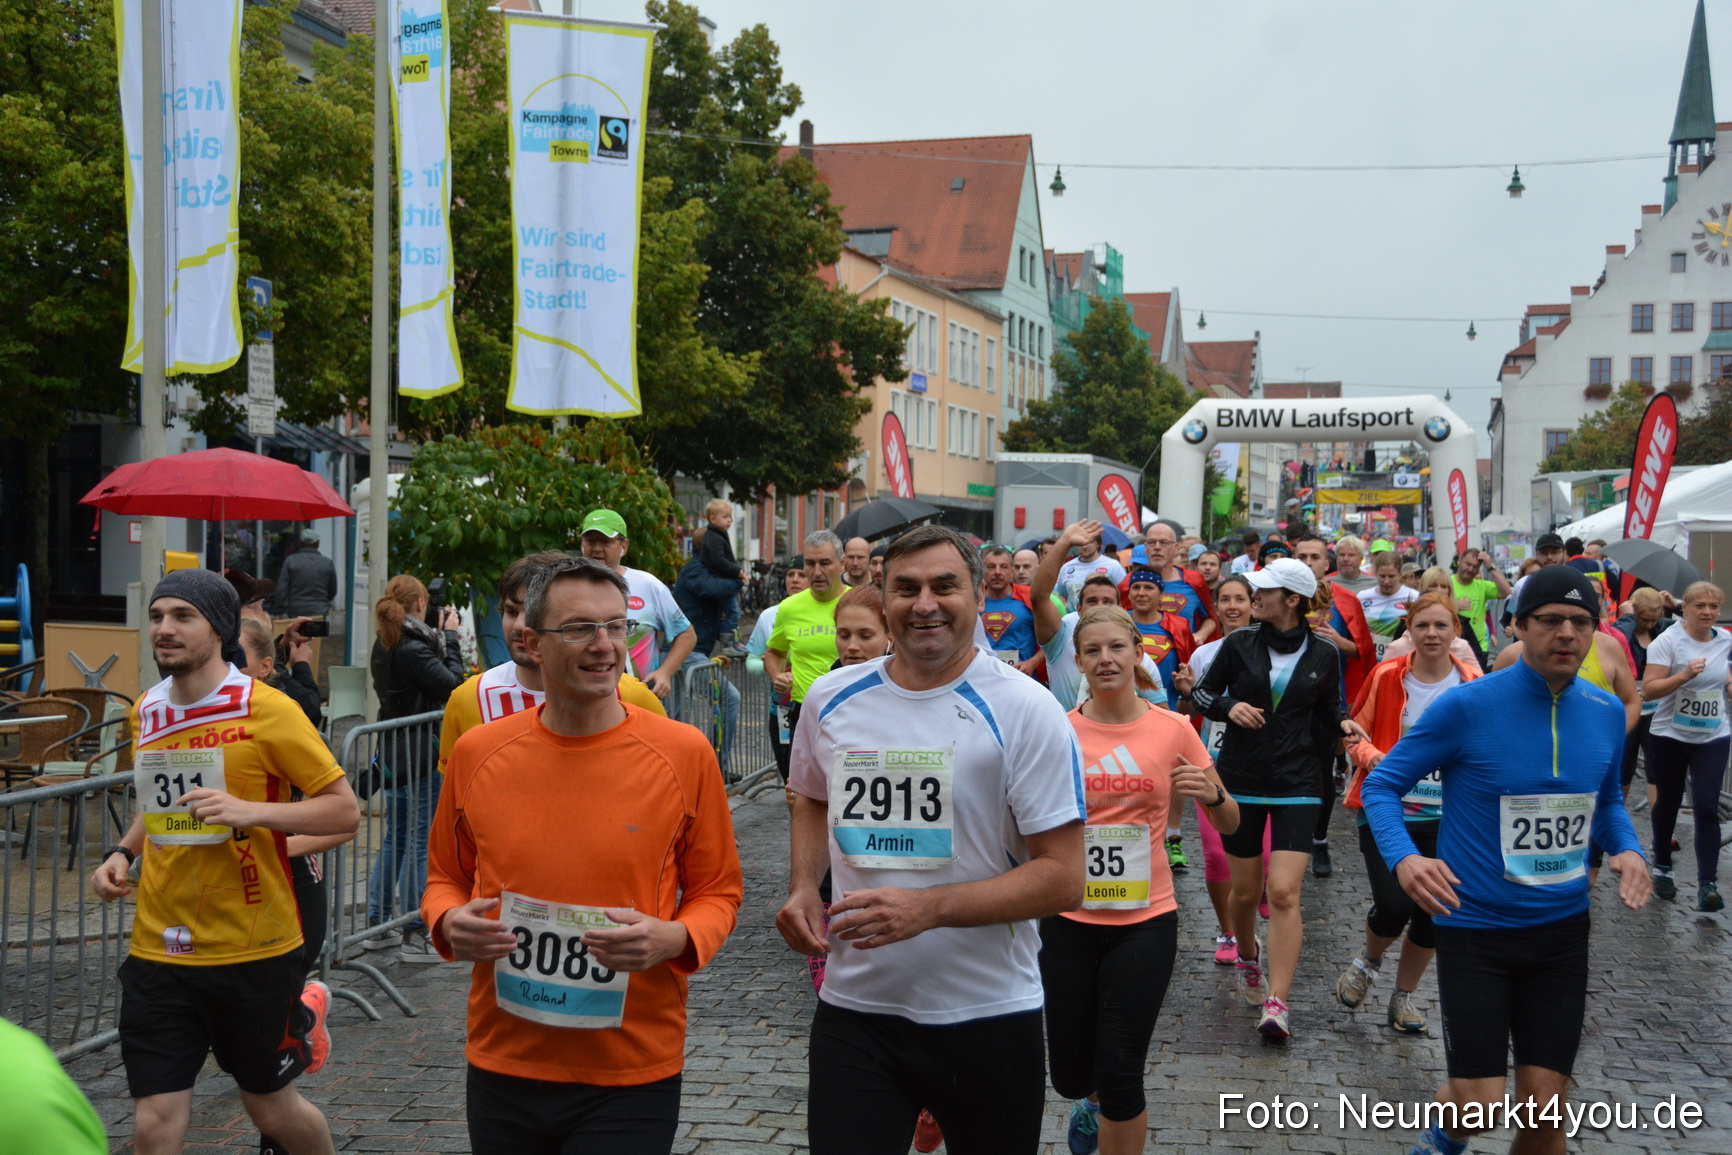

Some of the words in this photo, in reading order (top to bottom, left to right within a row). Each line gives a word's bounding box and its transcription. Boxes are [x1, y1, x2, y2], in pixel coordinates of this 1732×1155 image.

[523, 111, 588, 126] Kampagne
[522, 124, 595, 141] Fairtrade
[551, 145, 588, 158] Towns
[520, 226, 559, 247] Wir
[565, 227, 606, 251] sind
[520, 257, 627, 283] Fairtrade-
[523, 288, 587, 311] Stadt!
[1216, 408, 1285, 428] BMW
[1291, 407, 1414, 431] Laufsport
[887, 430, 909, 498] WE
[1628, 415, 1672, 539] REWE
[1357, 492, 1381, 502] ZIEL
[1451, 477, 1466, 539] REWE
[1679, 698, 1718, 717] 2908
[189, 726, 254, 750] BÖGL
[171, 752, 215, 764] BOCK
[885, 751, 944, 765] BOCK
[842, 776, 942, 822] 2913
[1088, 796, 1143, 807] RUNNING
[1547, 796, 1589, 809] BOCK
[1099, 827, 1142, 838] BOCK
[1512, 814, 1586, 850] 2582
[865, 834, 914, 852] Armin
[1088, 846, 1125, 877] 35
[1534, 859, 1567, 872] Issam
[1087, 885, 1127, 898] Leonie
[510, 907, 550, 921] NeuerMarkt
[520, 980, 567, 1007] Roland
